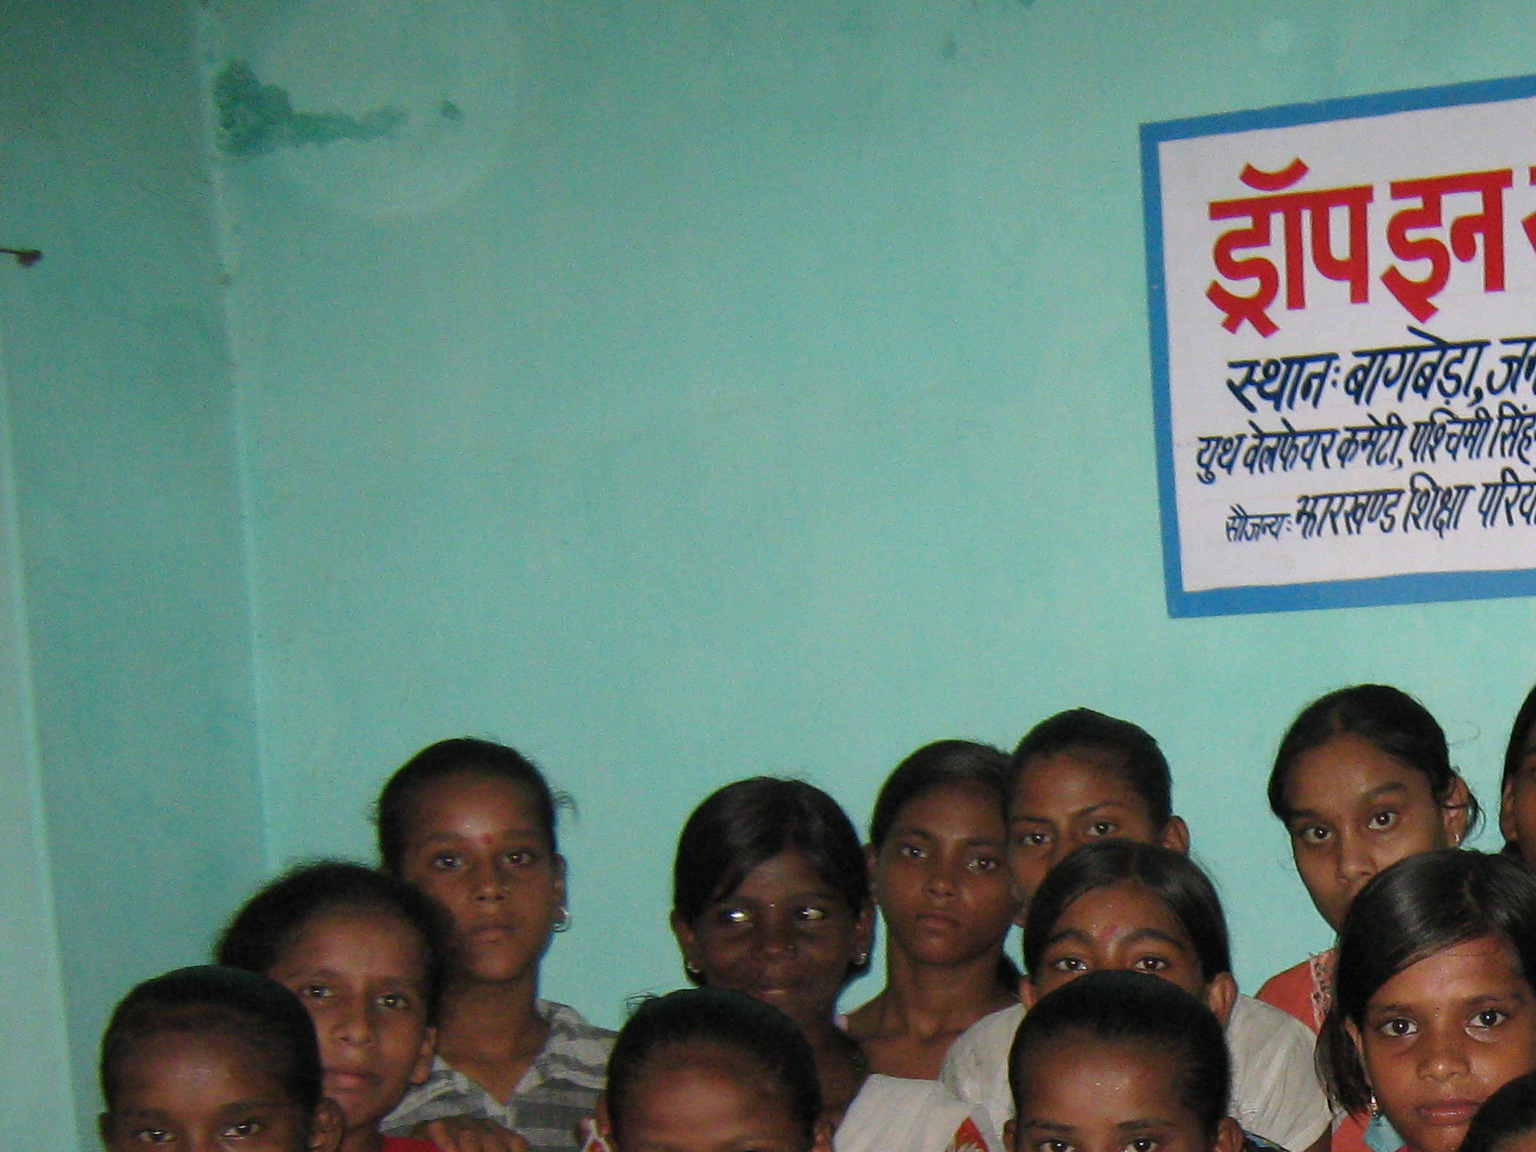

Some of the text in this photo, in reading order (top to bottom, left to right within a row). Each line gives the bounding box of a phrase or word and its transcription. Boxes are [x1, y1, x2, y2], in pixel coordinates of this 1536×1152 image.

[1205, 156, 1373, 338] ड्रॉप
[1380, 168, 1513, 323] इन
[1243, 419, 1340, 475] वेलफेयर
[1409, 407, 1493, 463] पश्चिमी
[1296, 488, 1405, 540] झारखण्ड
[1402, 472, 1476, 538] शिक्षा
